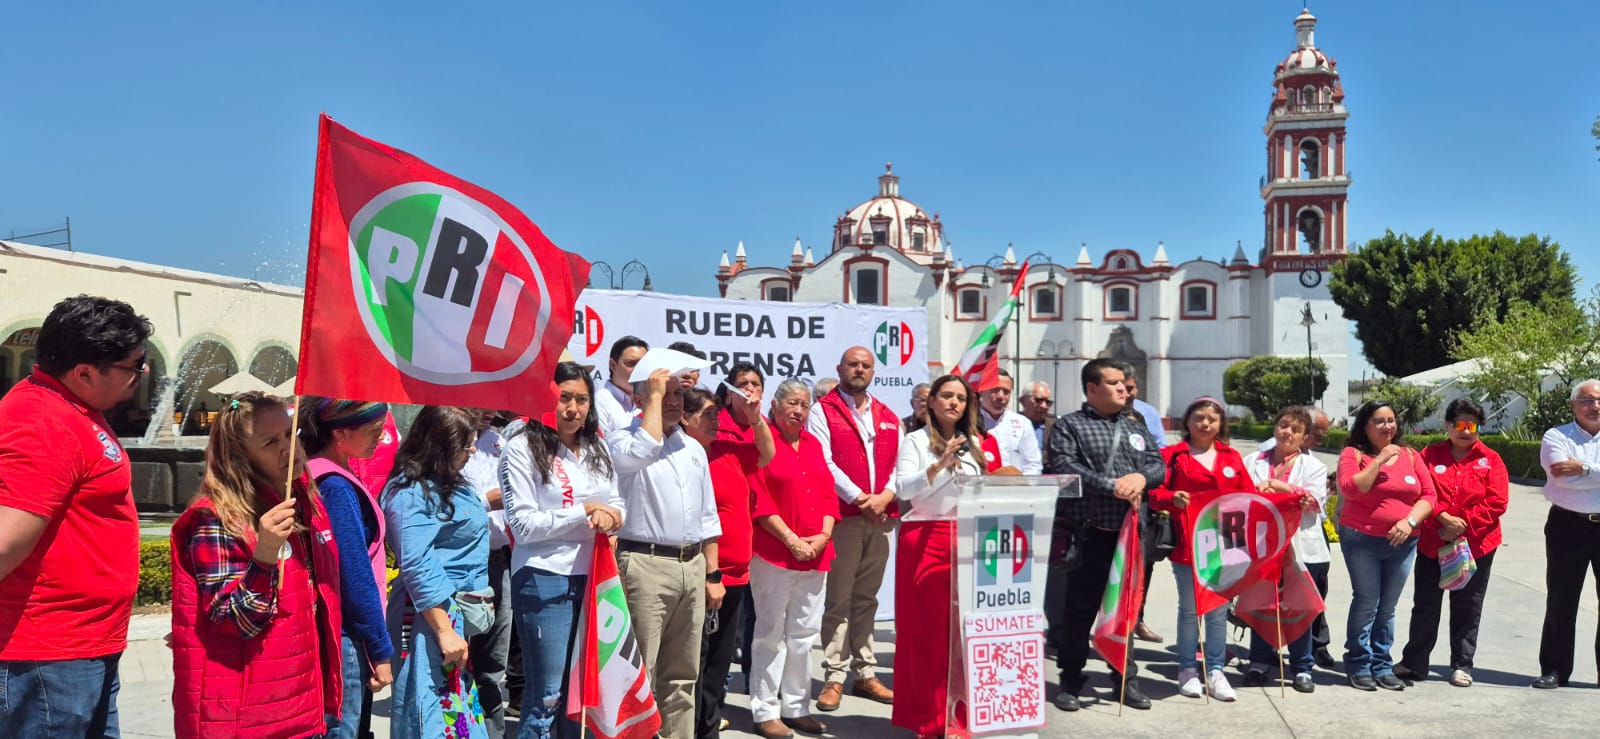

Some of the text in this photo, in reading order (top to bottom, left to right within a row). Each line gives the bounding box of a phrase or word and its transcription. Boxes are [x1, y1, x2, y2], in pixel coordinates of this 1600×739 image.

[367, 217, 525, 350] PRI
[574, 309, 599, 345] RI
[665, 308, 825, 339] RUEDA DE
[875, 325, 911, 355] PRI
[874, 376, 914, 387] PUEBLA
[984, 528, 1023, 566] PRI
[1197, 510, 1268, 573] PRI
[976, 587, 1032, 609] Puebla
